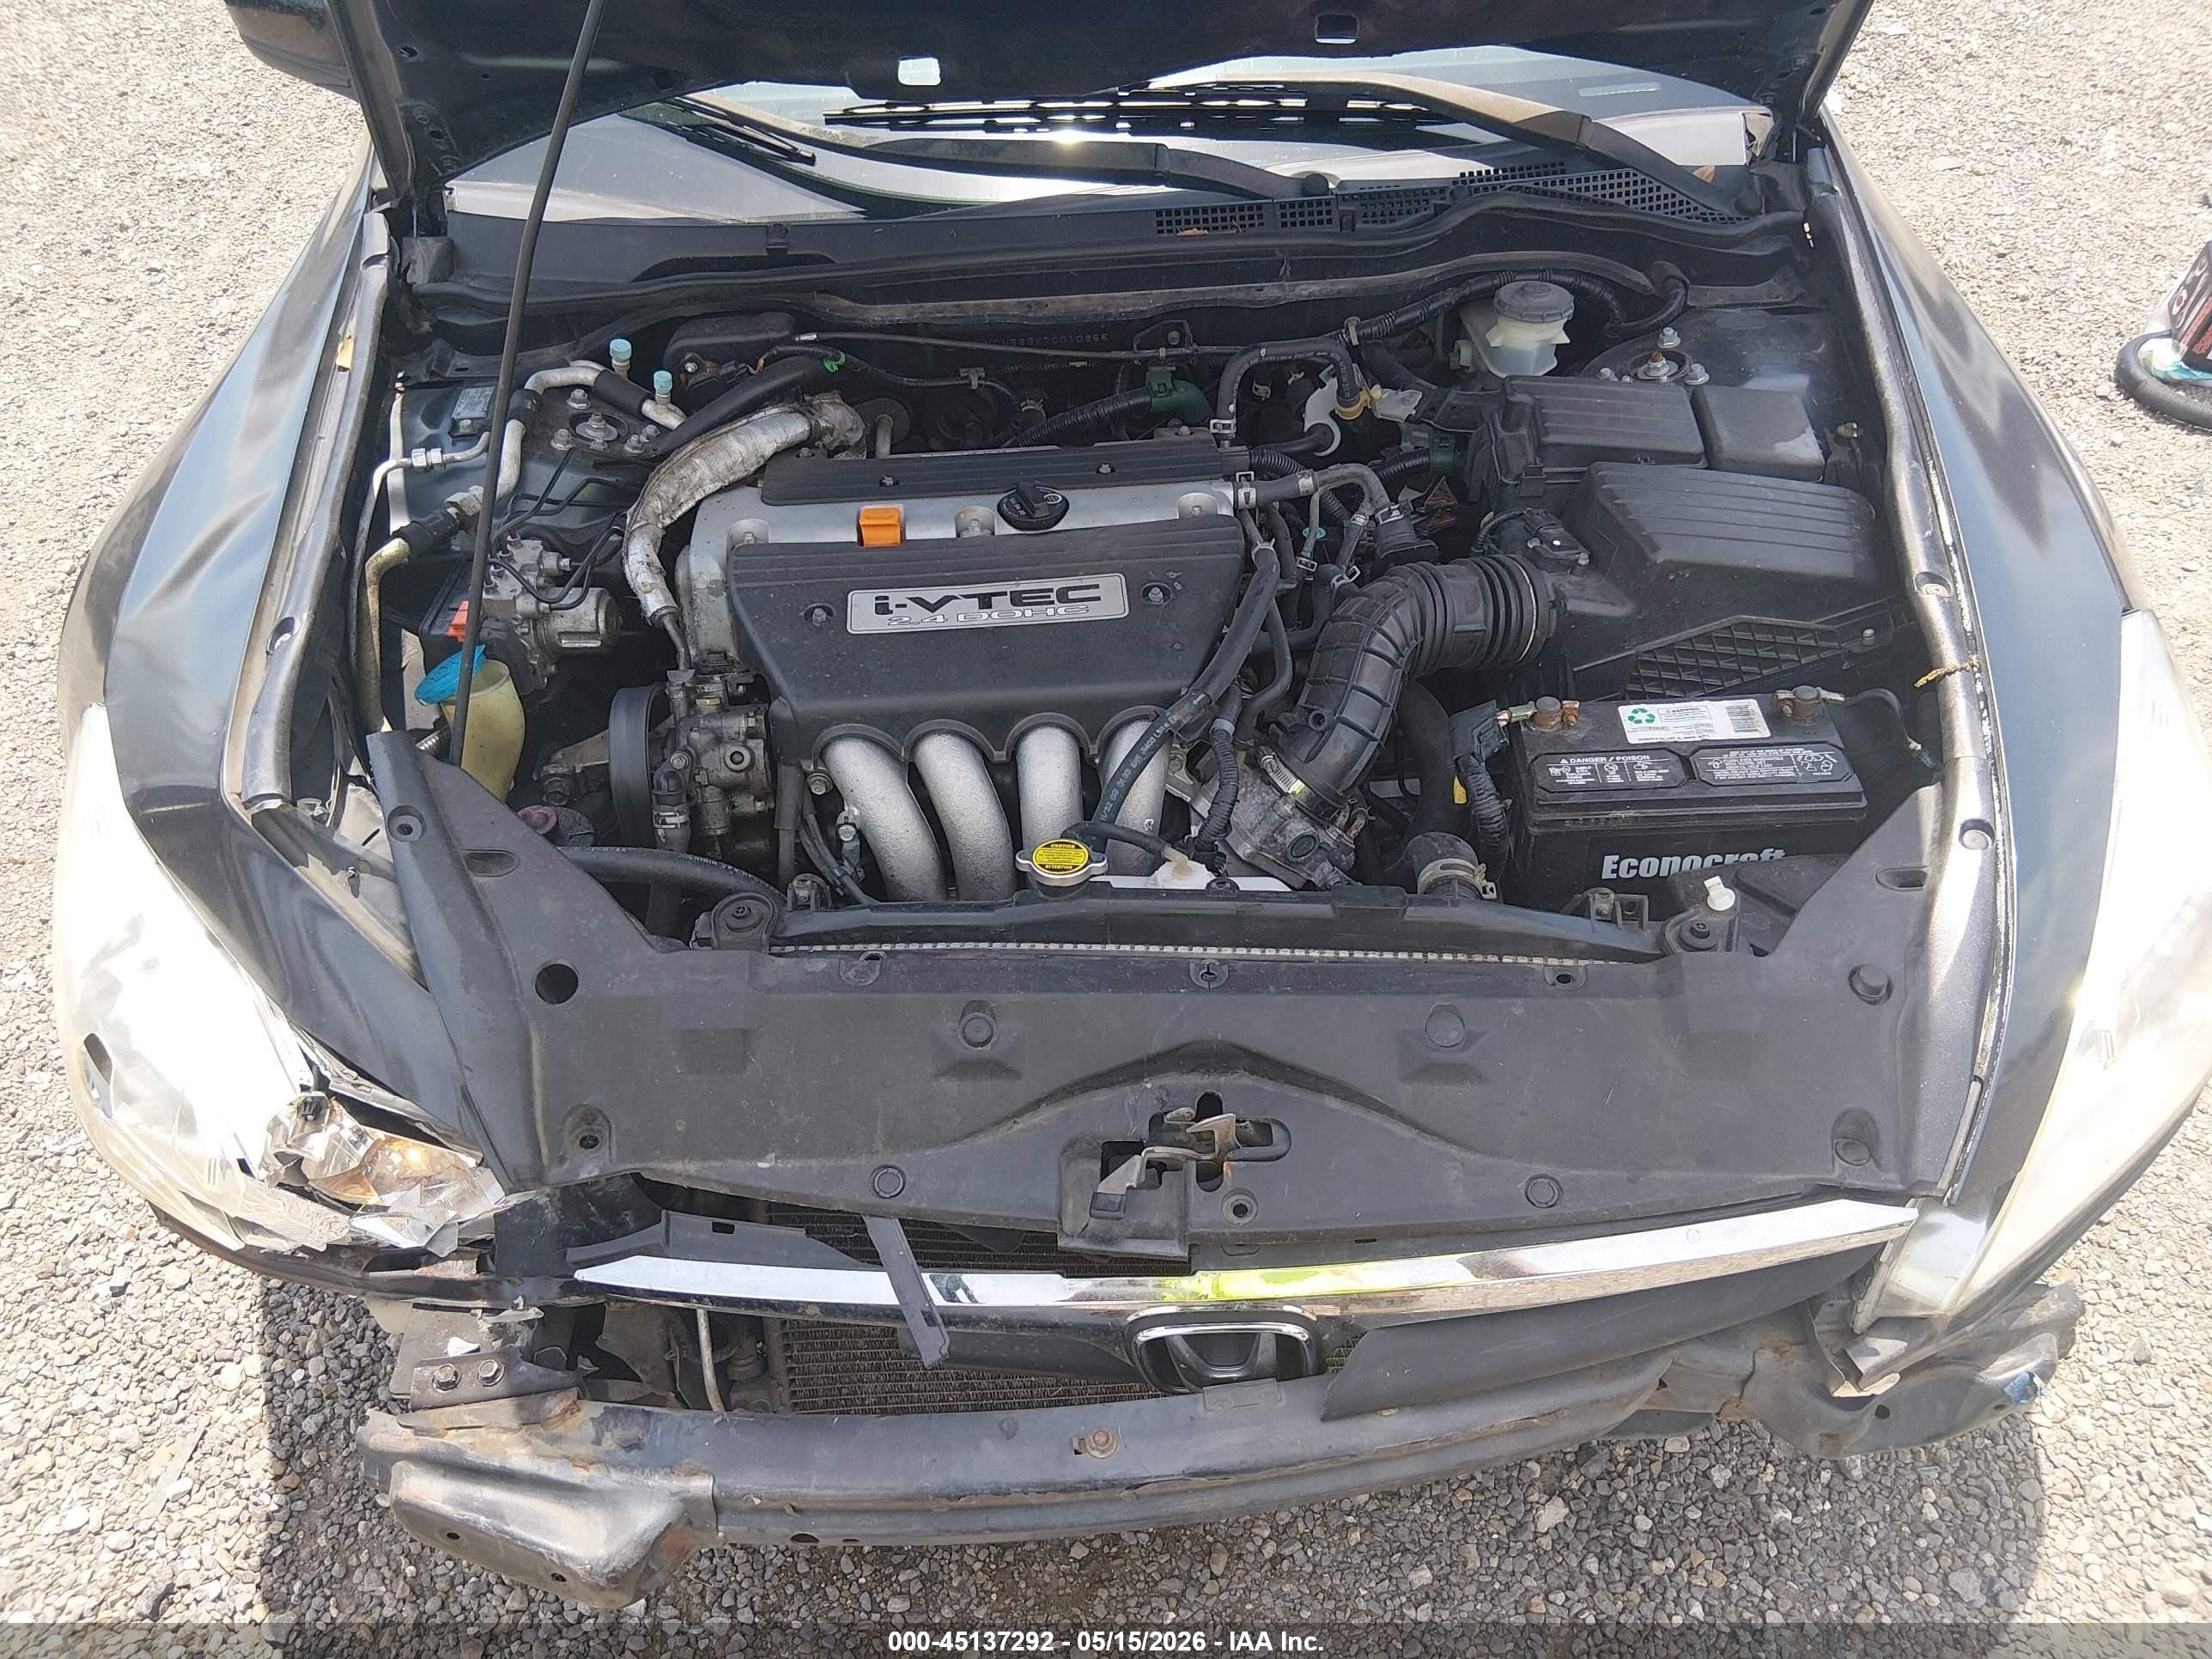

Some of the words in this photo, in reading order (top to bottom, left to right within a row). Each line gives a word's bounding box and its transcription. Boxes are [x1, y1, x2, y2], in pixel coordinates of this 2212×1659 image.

[874, 584, 1102, 616] i-VTEC
[887, 613, 949, 627] 2.4
[957, 605, 1090, 623] DOHC
